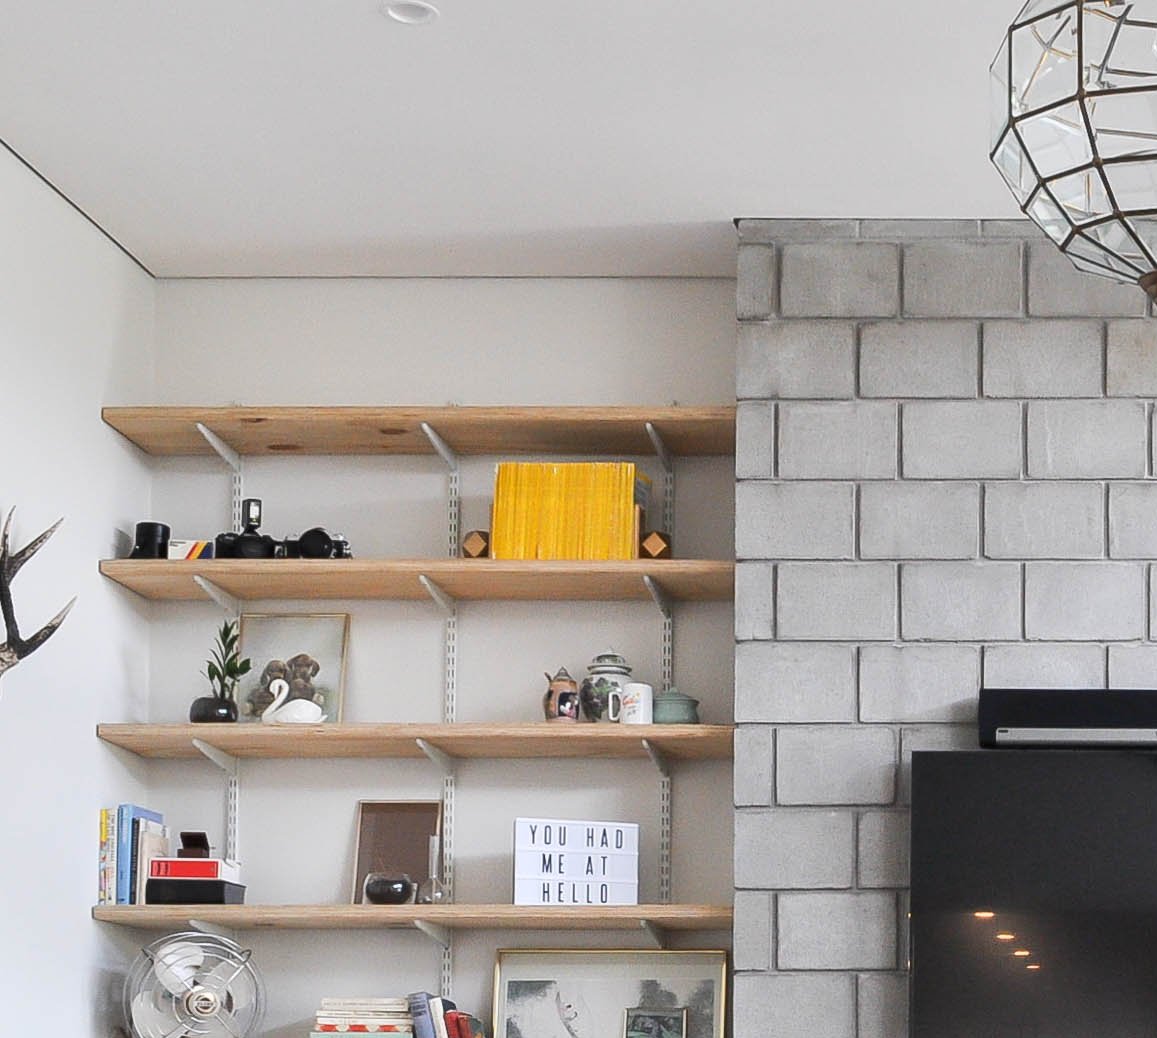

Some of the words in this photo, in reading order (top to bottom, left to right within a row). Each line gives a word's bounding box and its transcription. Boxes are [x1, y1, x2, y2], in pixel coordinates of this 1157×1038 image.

[529, 824, 566, 846] YOU
[586, 827, 623, 849] HAD
[542, 853, 565, 874] ME
[586, 855, 608, 876] AT
[542, 882, 608, 904] HELLO
